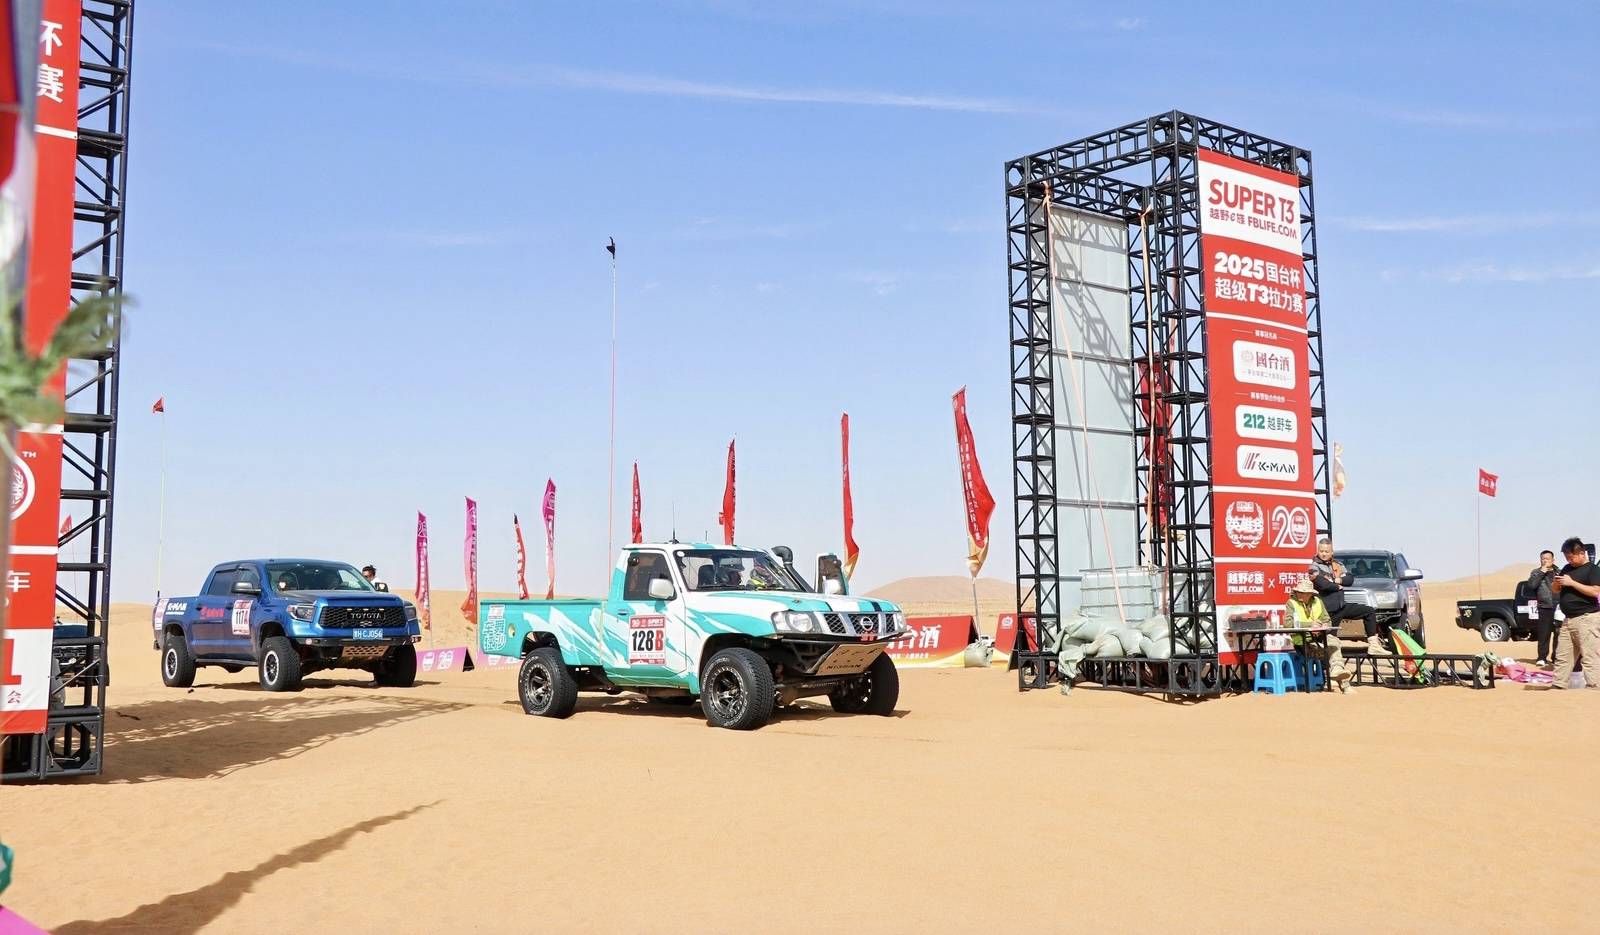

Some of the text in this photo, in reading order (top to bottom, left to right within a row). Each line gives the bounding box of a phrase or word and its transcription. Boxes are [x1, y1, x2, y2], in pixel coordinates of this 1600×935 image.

[1208, 179, 1295, 225] SUPER T3
[1248, 216, 1298, 240] FBLIFE.COM
[1215, 276, 1304, 314] 超级T3拉力赛
[1243, 413, 1293, 432] 212 越野车
[632, 630, 664, 651] 128B
